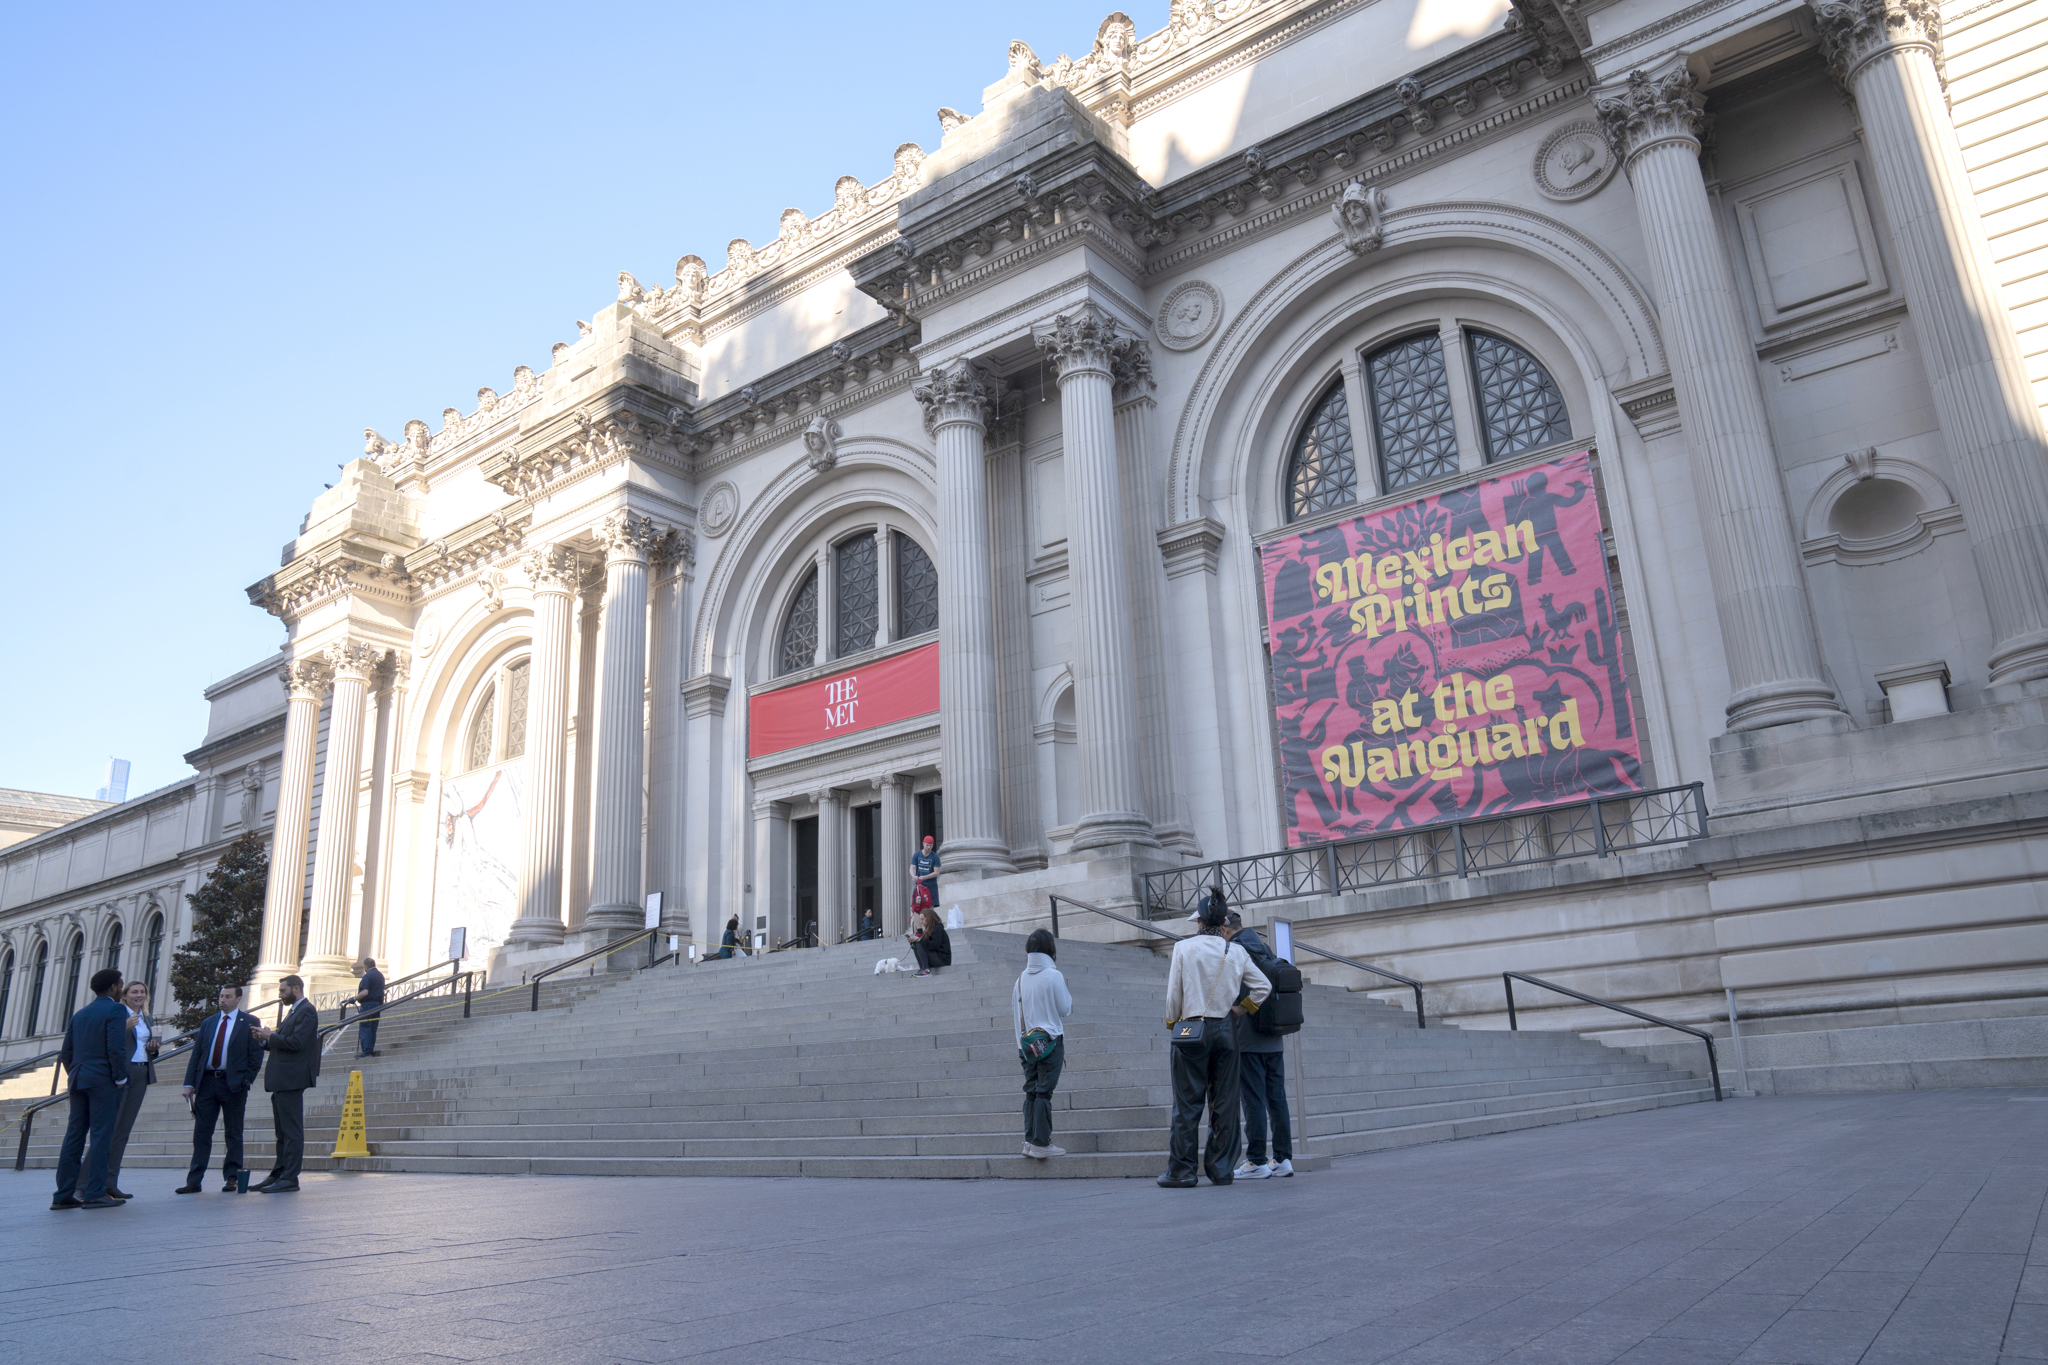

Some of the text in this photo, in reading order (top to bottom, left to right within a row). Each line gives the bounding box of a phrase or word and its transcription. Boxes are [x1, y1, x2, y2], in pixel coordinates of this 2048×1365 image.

[1316, 520, 1540, 604] Mexican
[1349, 572, 1512, 639] Prints
[824, 700, 859, 730] MET
[825, 676, 858, 705] THE
[1372, 671, 1516, 735] at the
[1321, 698, 1586, 787] Vanguard
